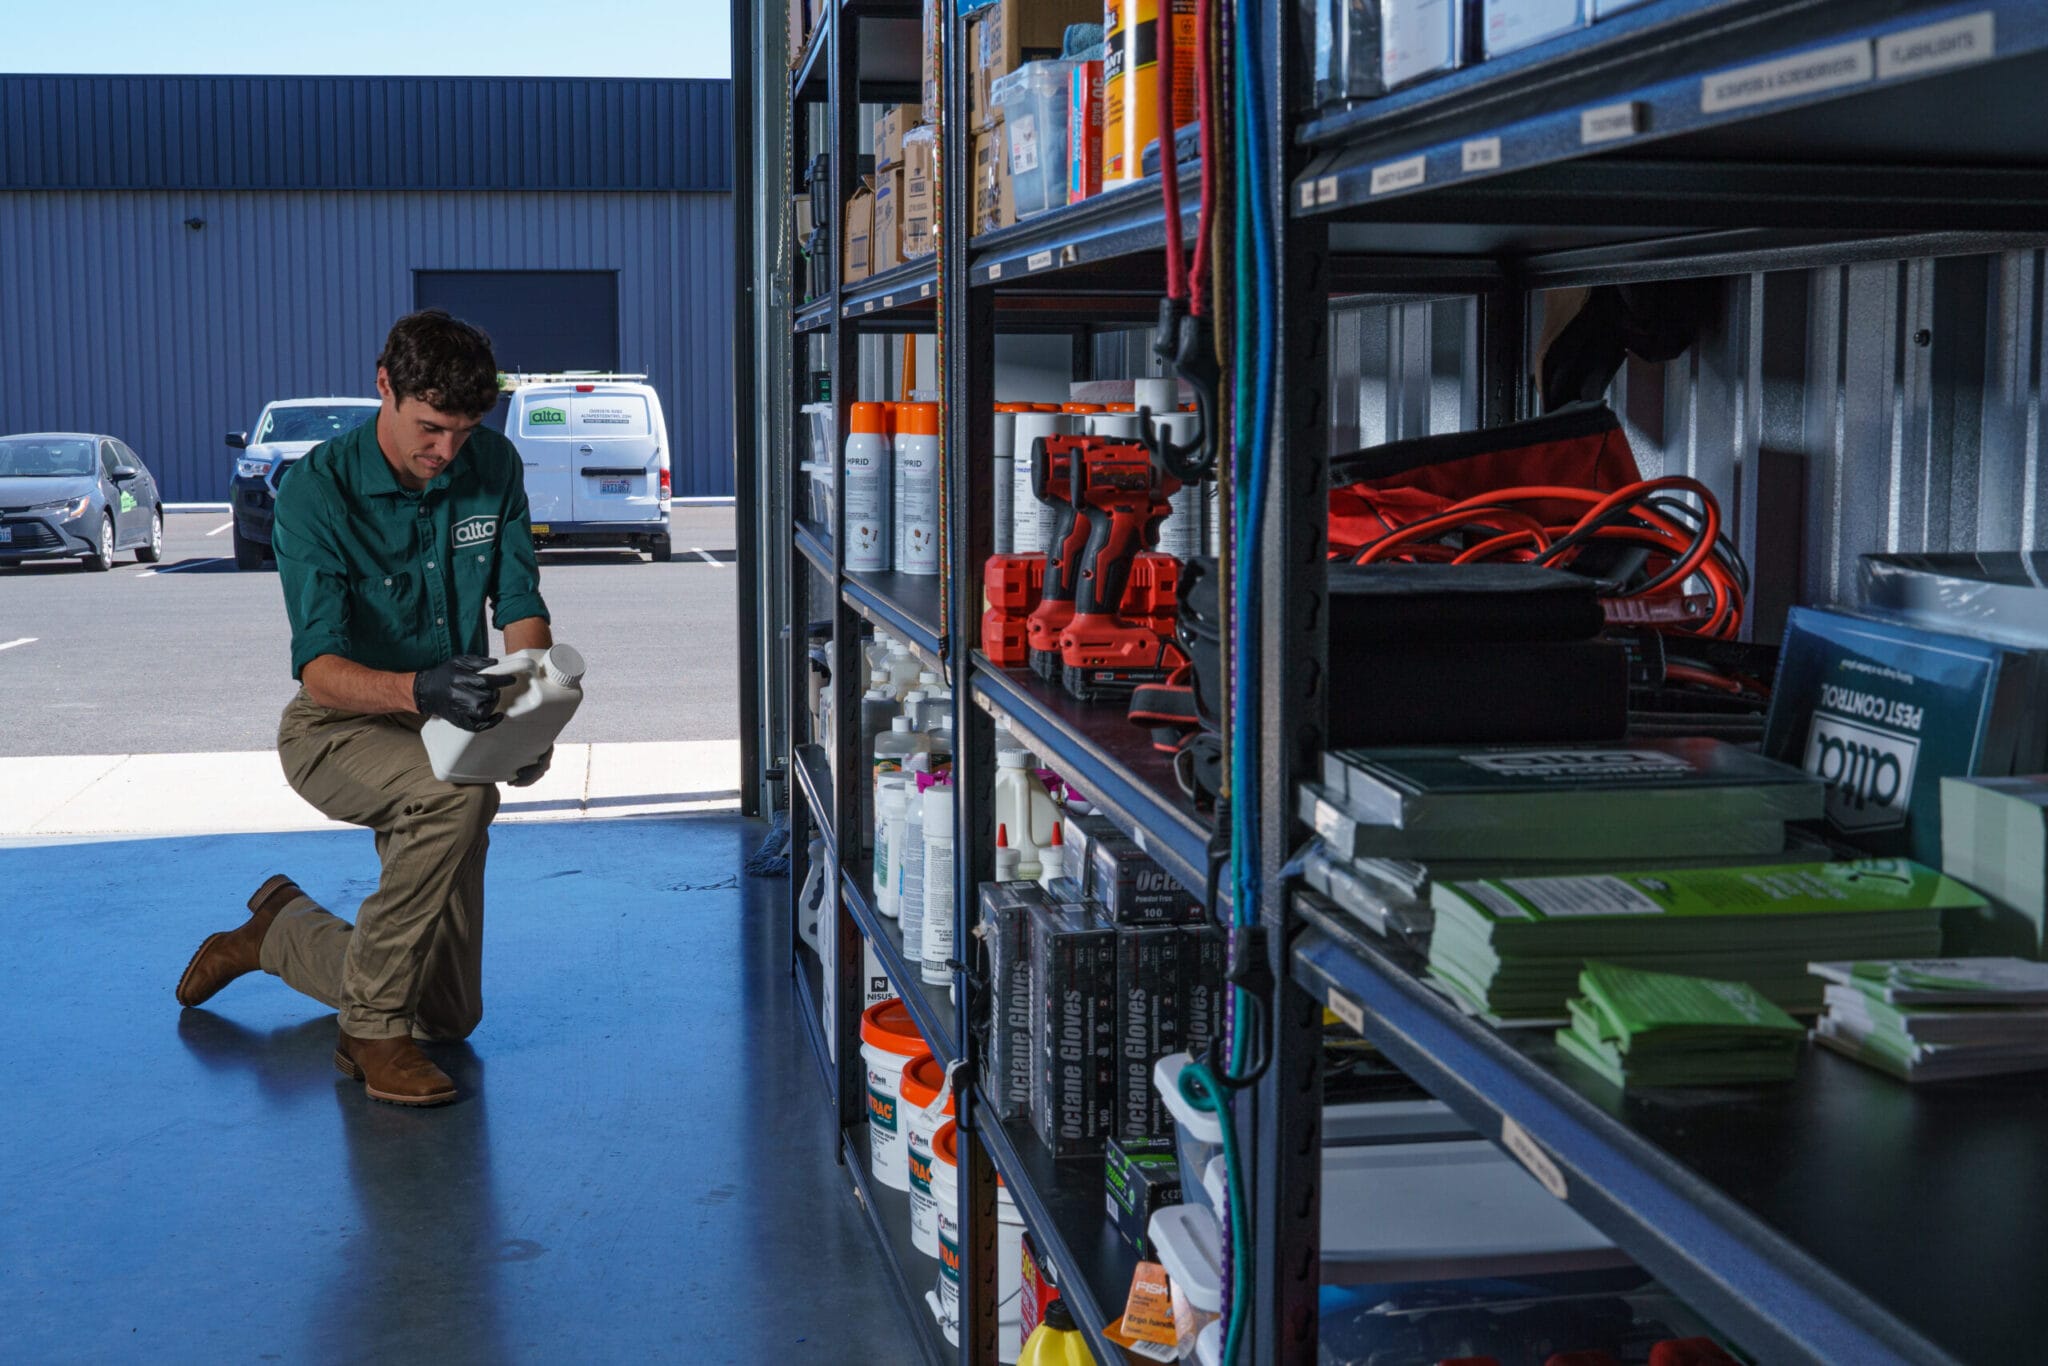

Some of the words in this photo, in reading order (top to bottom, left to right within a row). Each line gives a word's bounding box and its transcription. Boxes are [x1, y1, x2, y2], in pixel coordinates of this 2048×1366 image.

[532, 410, 563, 423] alta
[456, 520, 496, 542] alta
[1821, 683, 1886, 721] CONTROL
[1884, 701, 1924, 731] PEST
[1817, 732, 1902, 811] alta
[1136, 870, 1182, 891] Octa
[1144, 907, 1163, 918] 100
[1008, 960, 1030, 1028] Gloves
[1060, 990, 1083, 1061] Gloves
[1125, 989, 1147, 1059] Gloves
[1008, 1032, 1030, 1102] Octane
[1125, 1064, 1147, 1135] Octane
[1061, 1065, 1082, 1139] Octane
